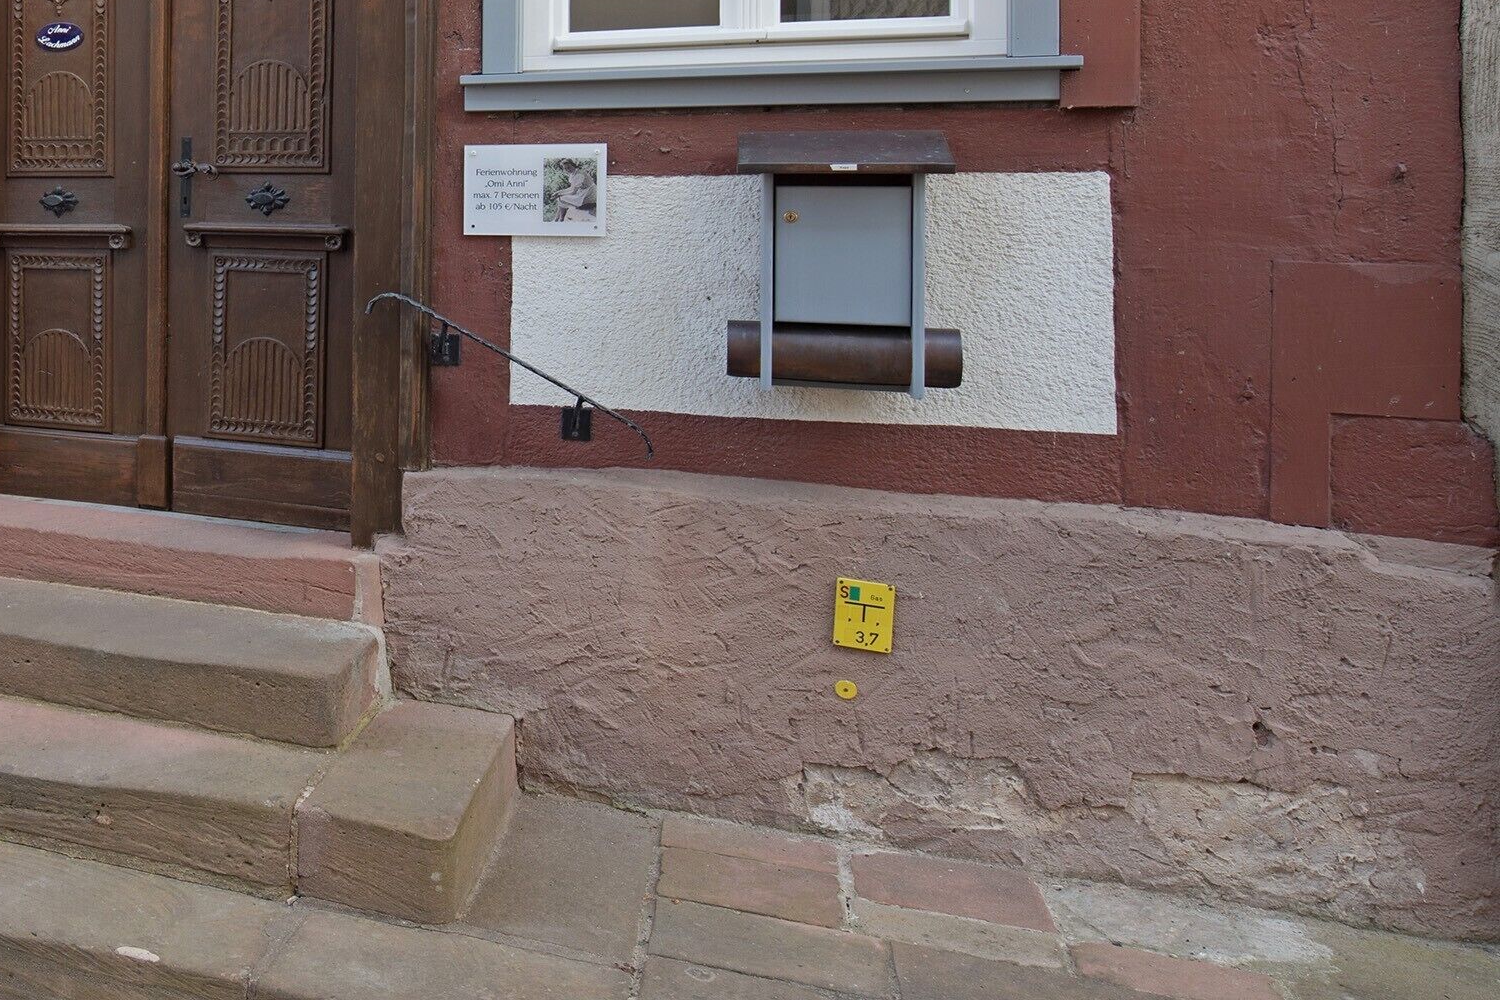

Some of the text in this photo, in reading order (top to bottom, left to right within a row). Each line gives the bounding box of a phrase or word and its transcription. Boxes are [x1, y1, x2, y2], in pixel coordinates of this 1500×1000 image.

[47, 24, 72, 35] Anni
[475, 168, 538, 178] Ferienwohnung
[501, 191, 540, 199] Personen
[870, 594, 883, 602] Gas
[855, 631, 879, 647] 3,7
